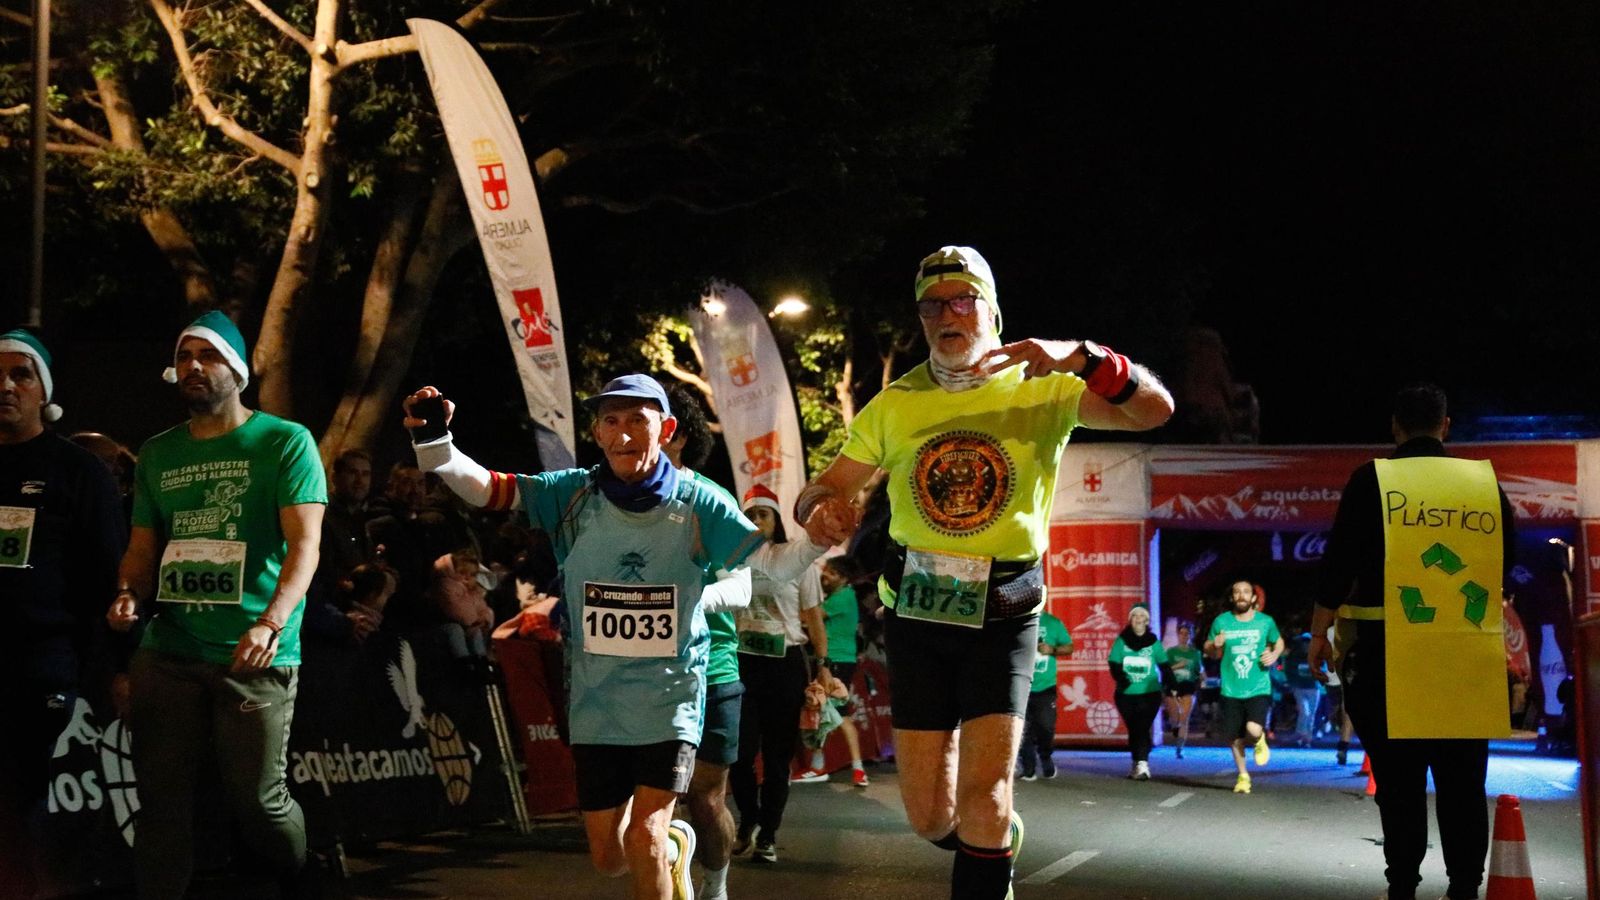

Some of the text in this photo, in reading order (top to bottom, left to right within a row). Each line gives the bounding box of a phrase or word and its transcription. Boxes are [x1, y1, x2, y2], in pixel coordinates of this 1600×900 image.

[160, 474, 193, 488] CIUDAD
[195, 472, 207, 482] DE
[209, 468, 250, 480] ALMERÍA
[180, 463, 200, 475] SAN
[201, 460, 250, 473] SILVESTRE
[175, 514, 217, 527] PROTEGE
[3, 536, 20, 557] 8
[166, 571, 235, 594] 1666
[905, 583, 978, 616] 1875
[586, 611, 673, 640] 10033
